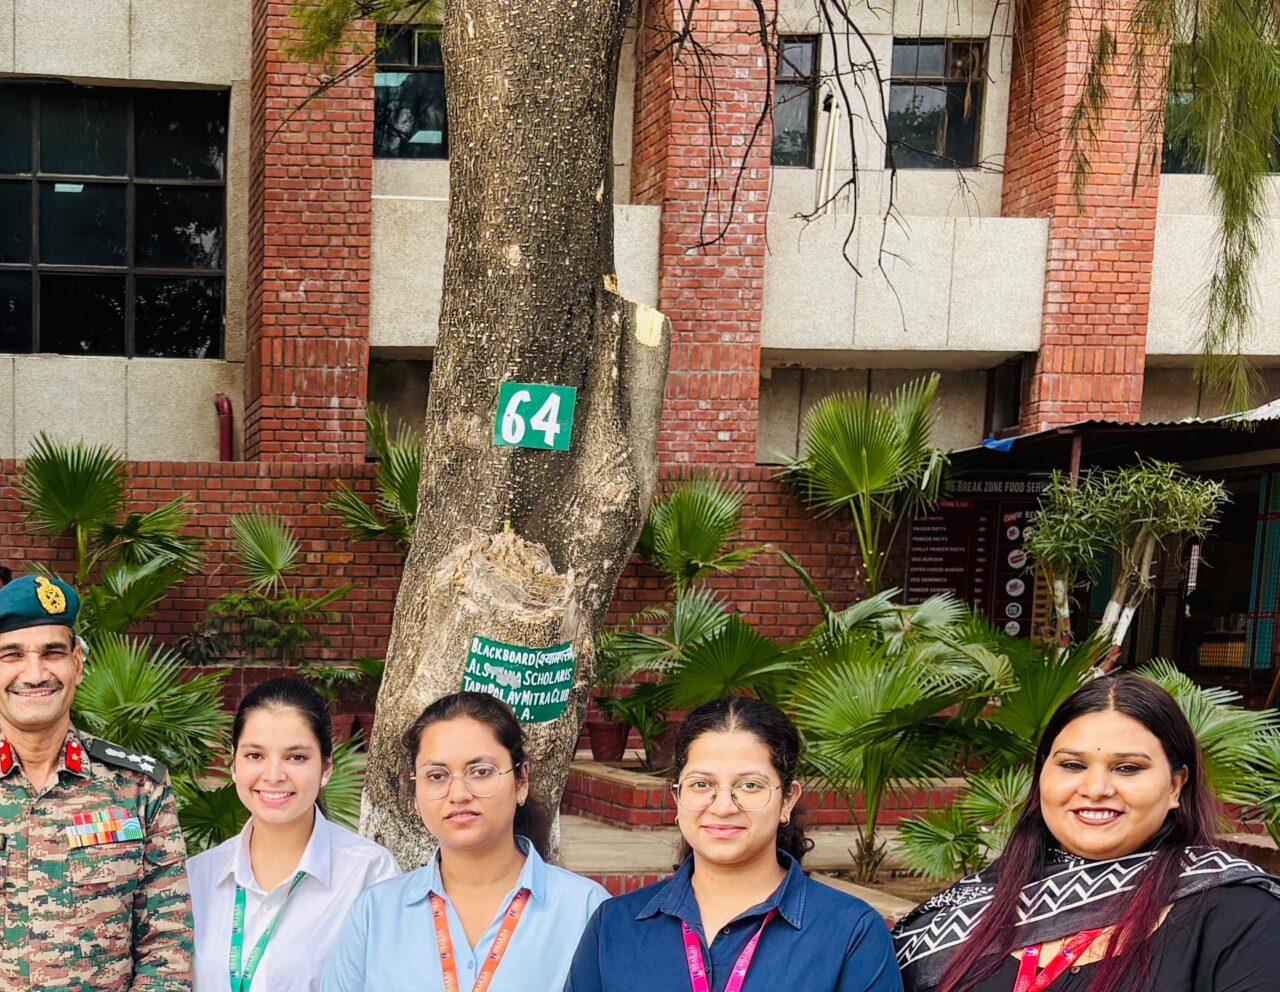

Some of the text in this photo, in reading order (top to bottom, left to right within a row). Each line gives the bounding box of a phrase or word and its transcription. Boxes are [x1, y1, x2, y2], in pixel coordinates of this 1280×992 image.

[501, 390, 561, 447] 64
[957, 481, 982, 493] BREAK
[984, 481, 1003, 493] ZONE
[1004, 481, 1025, 493] FOOD
[470, 637, 537, 667] BLACKBOARD
[523, 668, 573, 686] SCHOLARIS
[550, 687, 570, 704] CLUB
